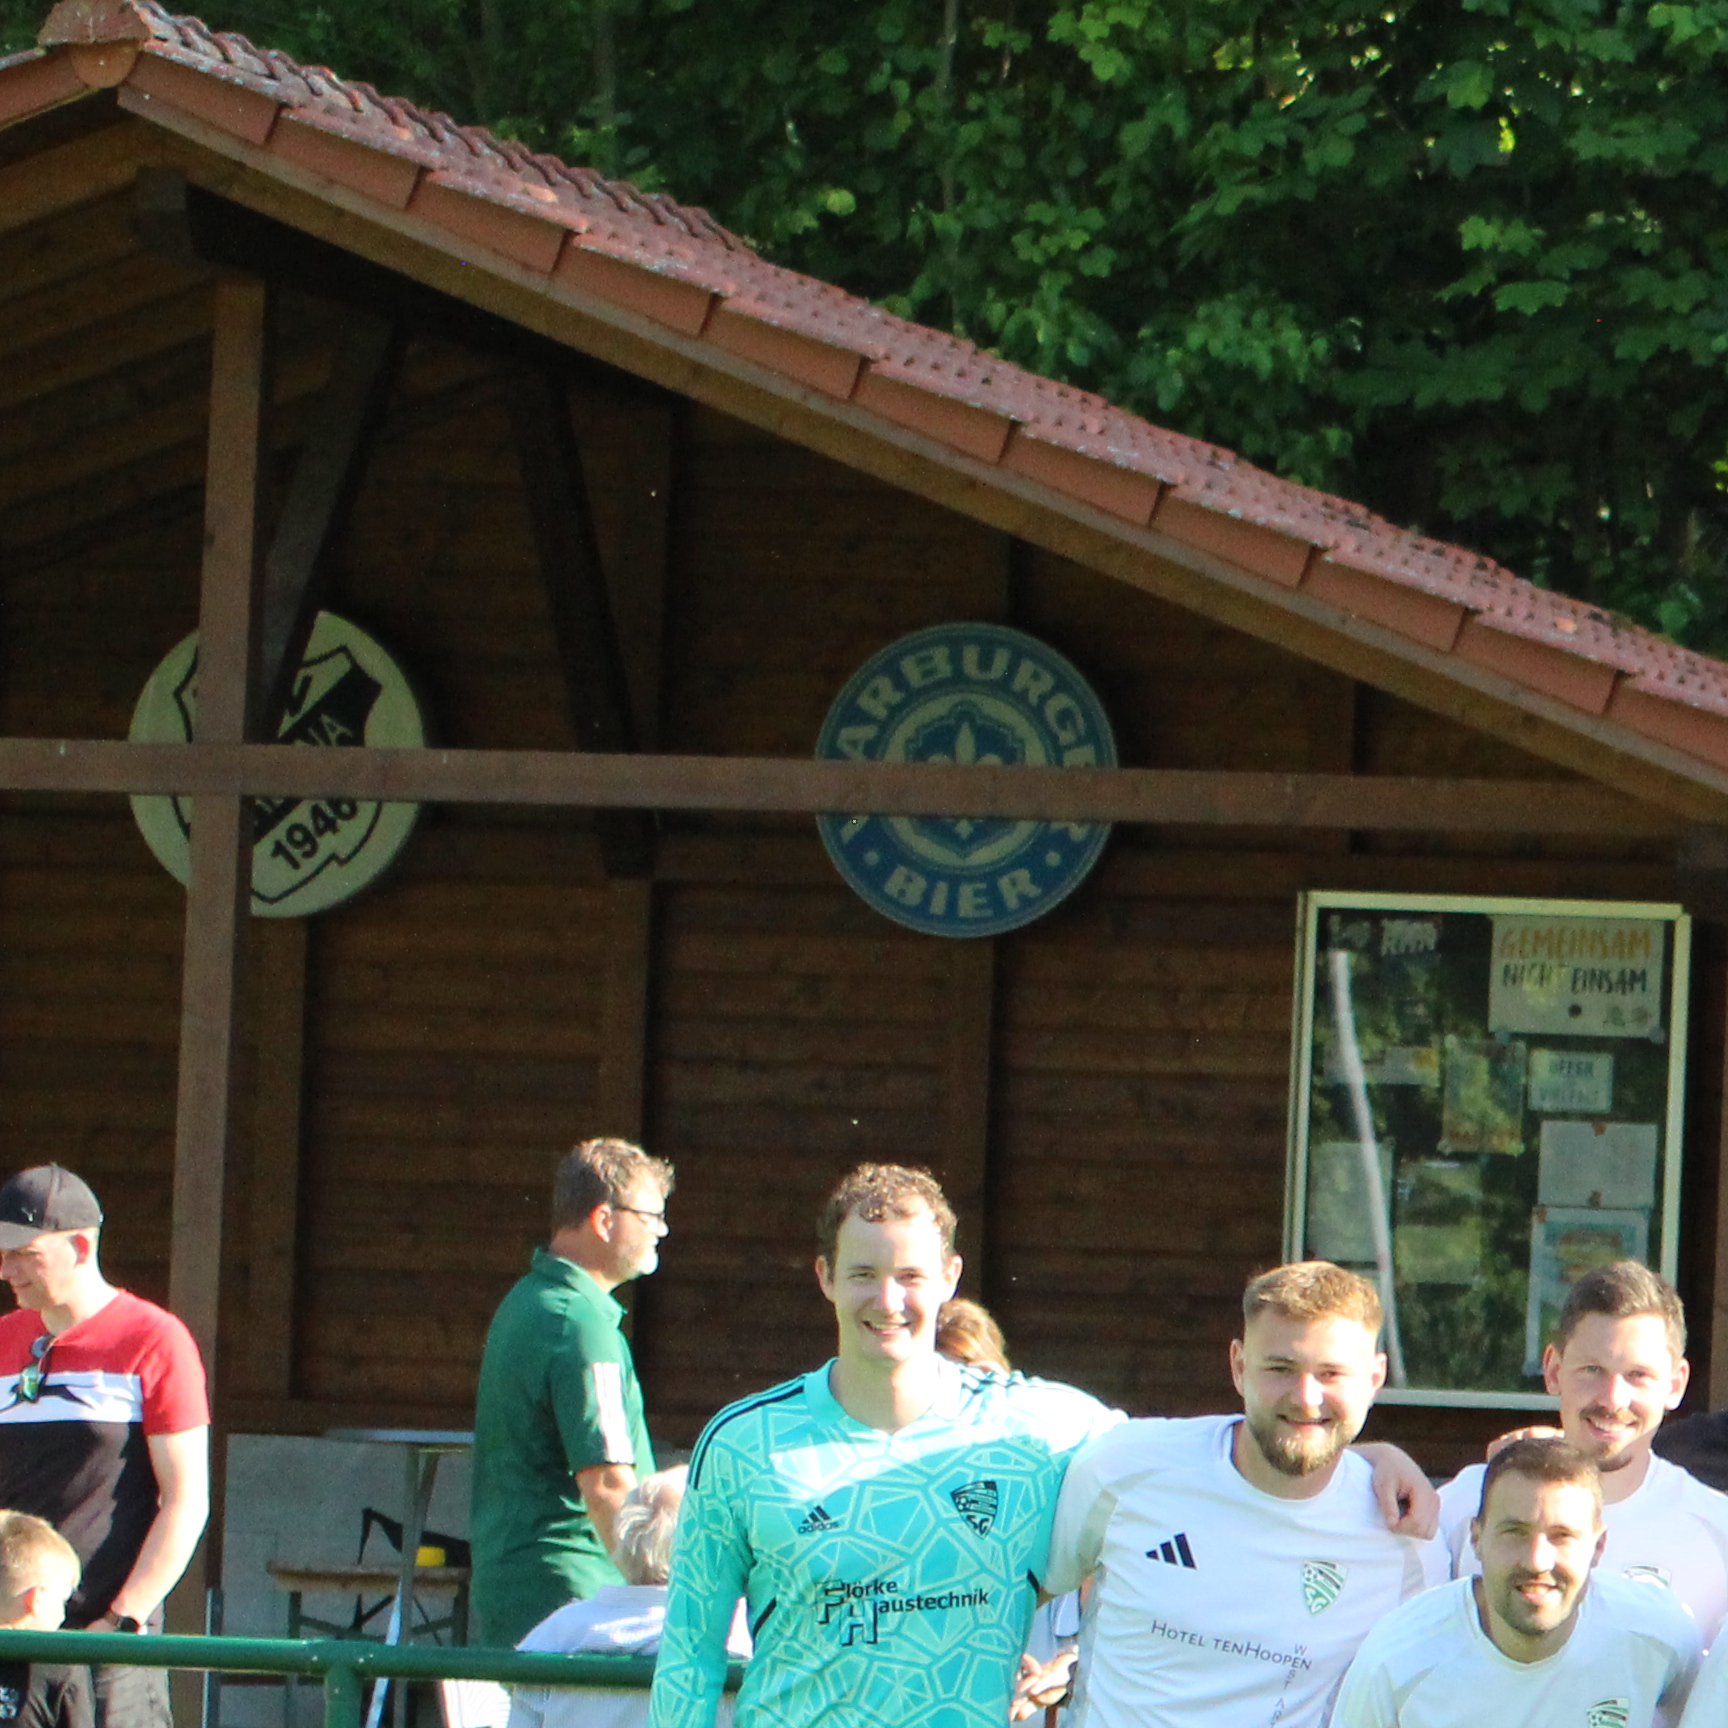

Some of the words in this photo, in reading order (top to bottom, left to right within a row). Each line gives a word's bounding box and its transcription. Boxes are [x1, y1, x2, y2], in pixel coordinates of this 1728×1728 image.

[839, 644, 1097, 845] ARBURG
[270, 799, 358, 871] 1946
[883, 866, 1041, 918] BIER
[1500, 926, 1651, 961] GEMEINSAM
[1571, 966, 1648, 996] EINSAM
[797, 1520, 839, 1534] adidas
[839, 1588, 989, 1647] Haustechnik
